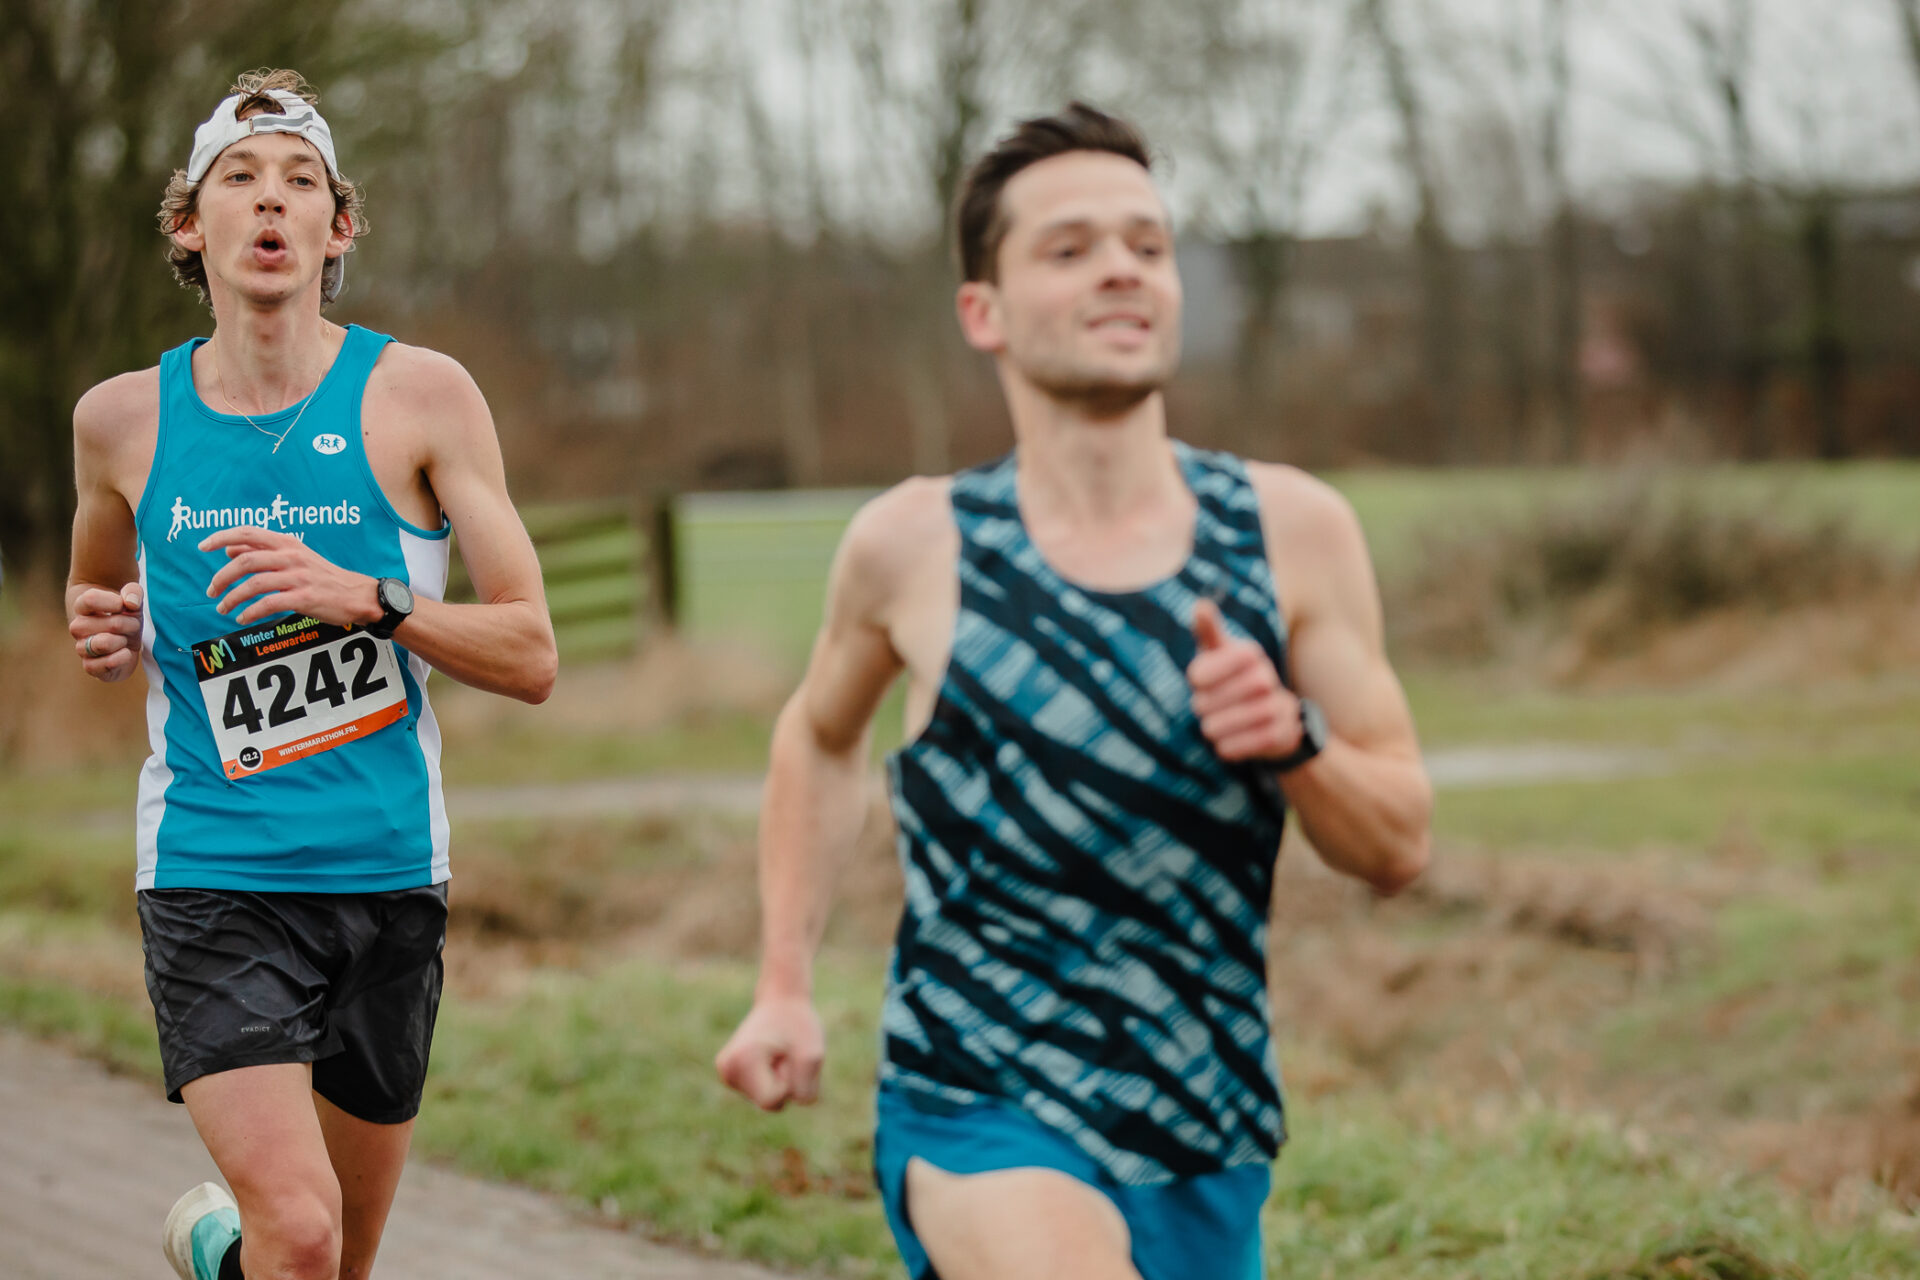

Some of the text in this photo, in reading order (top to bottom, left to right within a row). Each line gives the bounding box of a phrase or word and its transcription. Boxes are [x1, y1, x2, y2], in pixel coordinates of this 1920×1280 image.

[239, 616, 320, 647] Winter Maratho
[255, 630, 319, 657] Leeuwarden
[222, 636, 389, 735] 4242
[278, 724, 359, 757] WINTERMARATHON.FRL
[241, 751, 260, 762] 42.2
